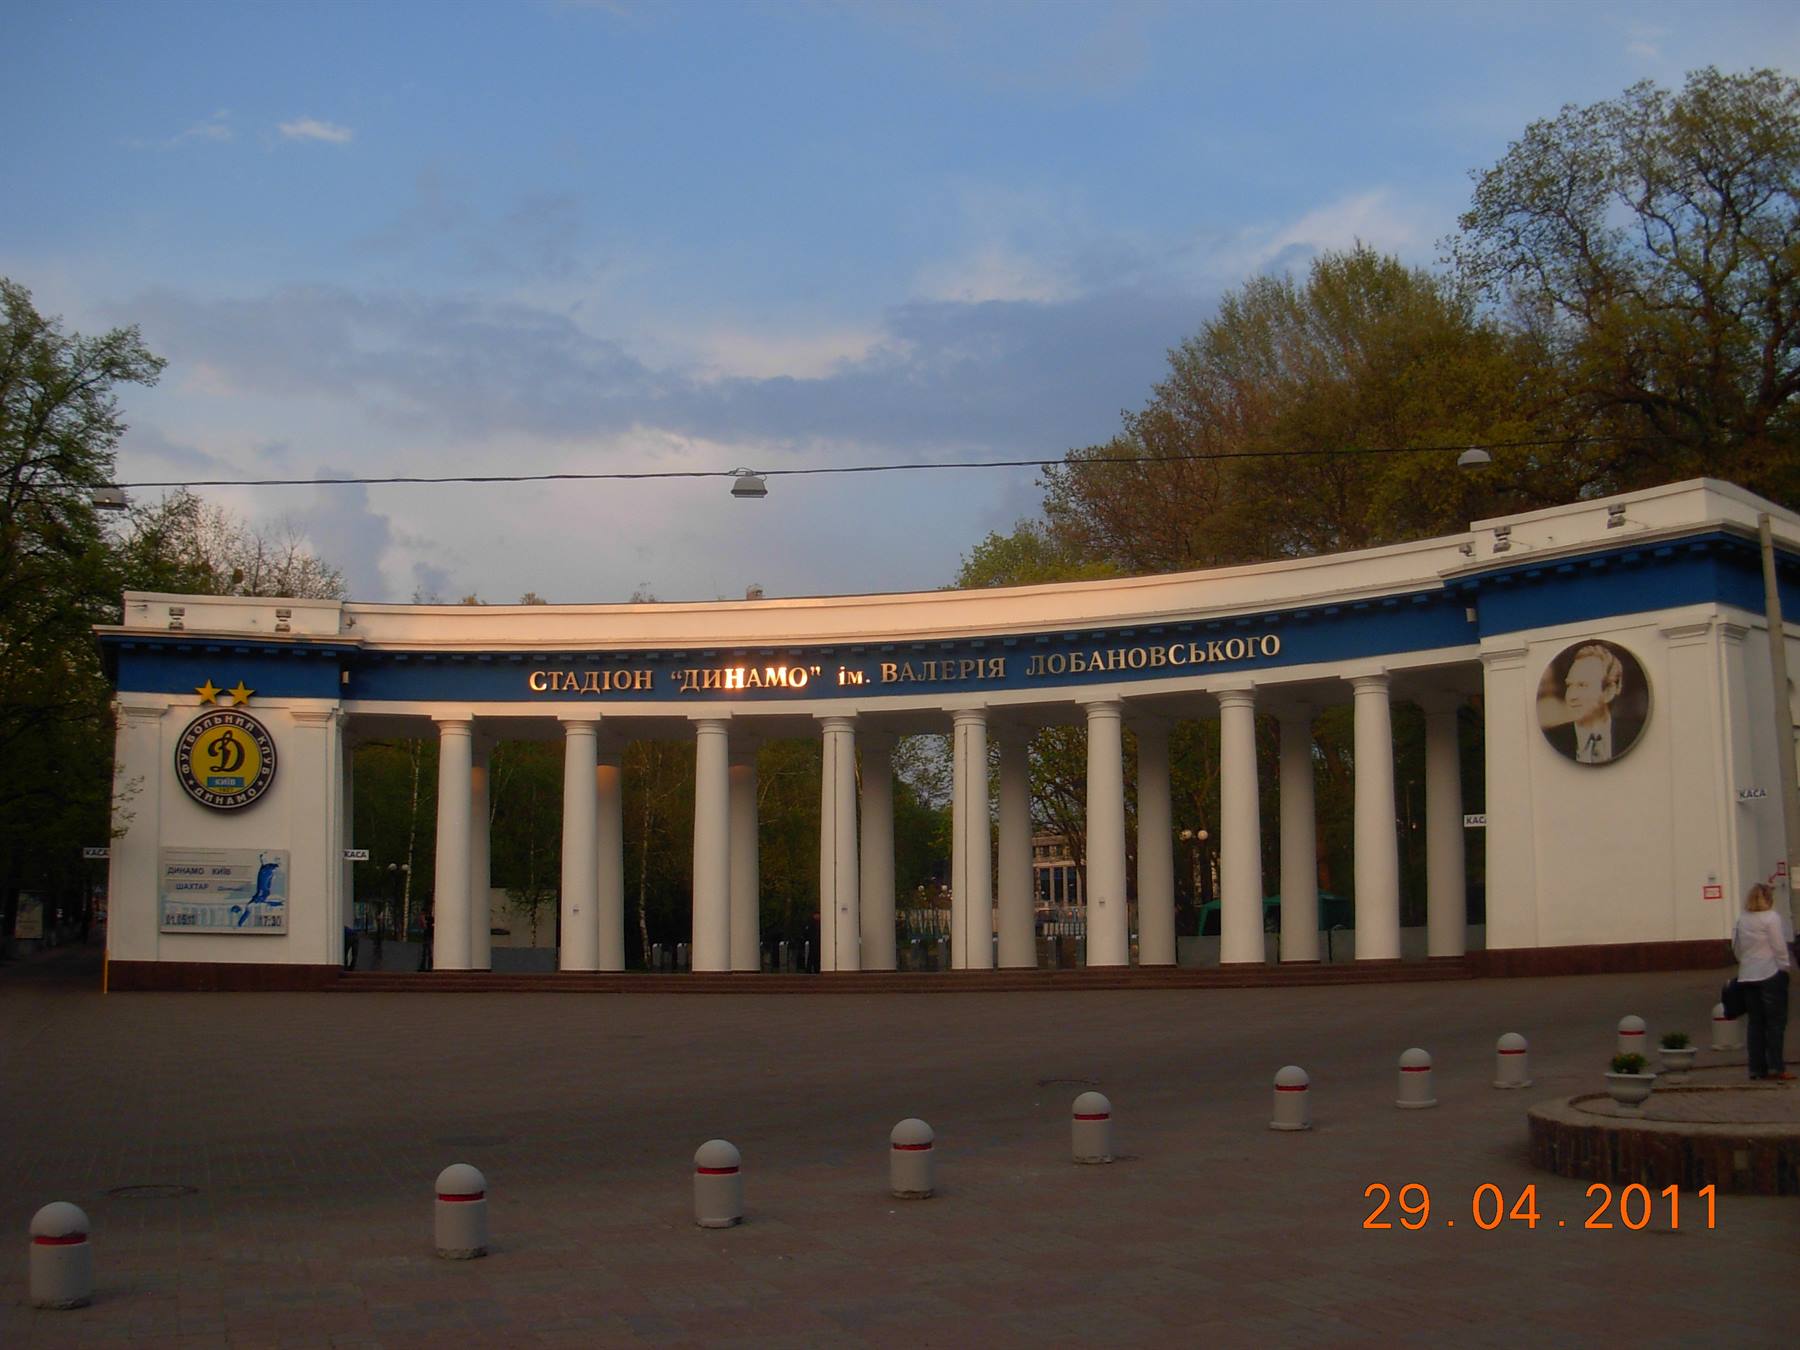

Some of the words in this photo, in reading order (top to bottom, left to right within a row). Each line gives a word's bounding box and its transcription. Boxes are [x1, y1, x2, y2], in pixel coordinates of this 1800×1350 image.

[529, 669, 653, 694] СТАДІОН
[838, 666, 870, 685] ім.
[880, 657, 1007, 683] ВАЛЕРІЯ
[1025, 634, 1282, 677] ЛОБАНОВСЬКОГО
[180, 714, 255, 774] ФУТБОЛЬНИЙ
[257, 735, 273, 775] КЛУБ
[214, 778, 236, 786] КИЇВ
[194, 788, 257, 805] ДИНАМО
[1739, 788, 1767, 798] КАСА
[343, 850, 367, 858] КАСА
[167, 866, 205, 875] ДИНАМО
[211, 865, 232, 875] КИЇВ
[175, 883, 209, 891] ШАХТАР
